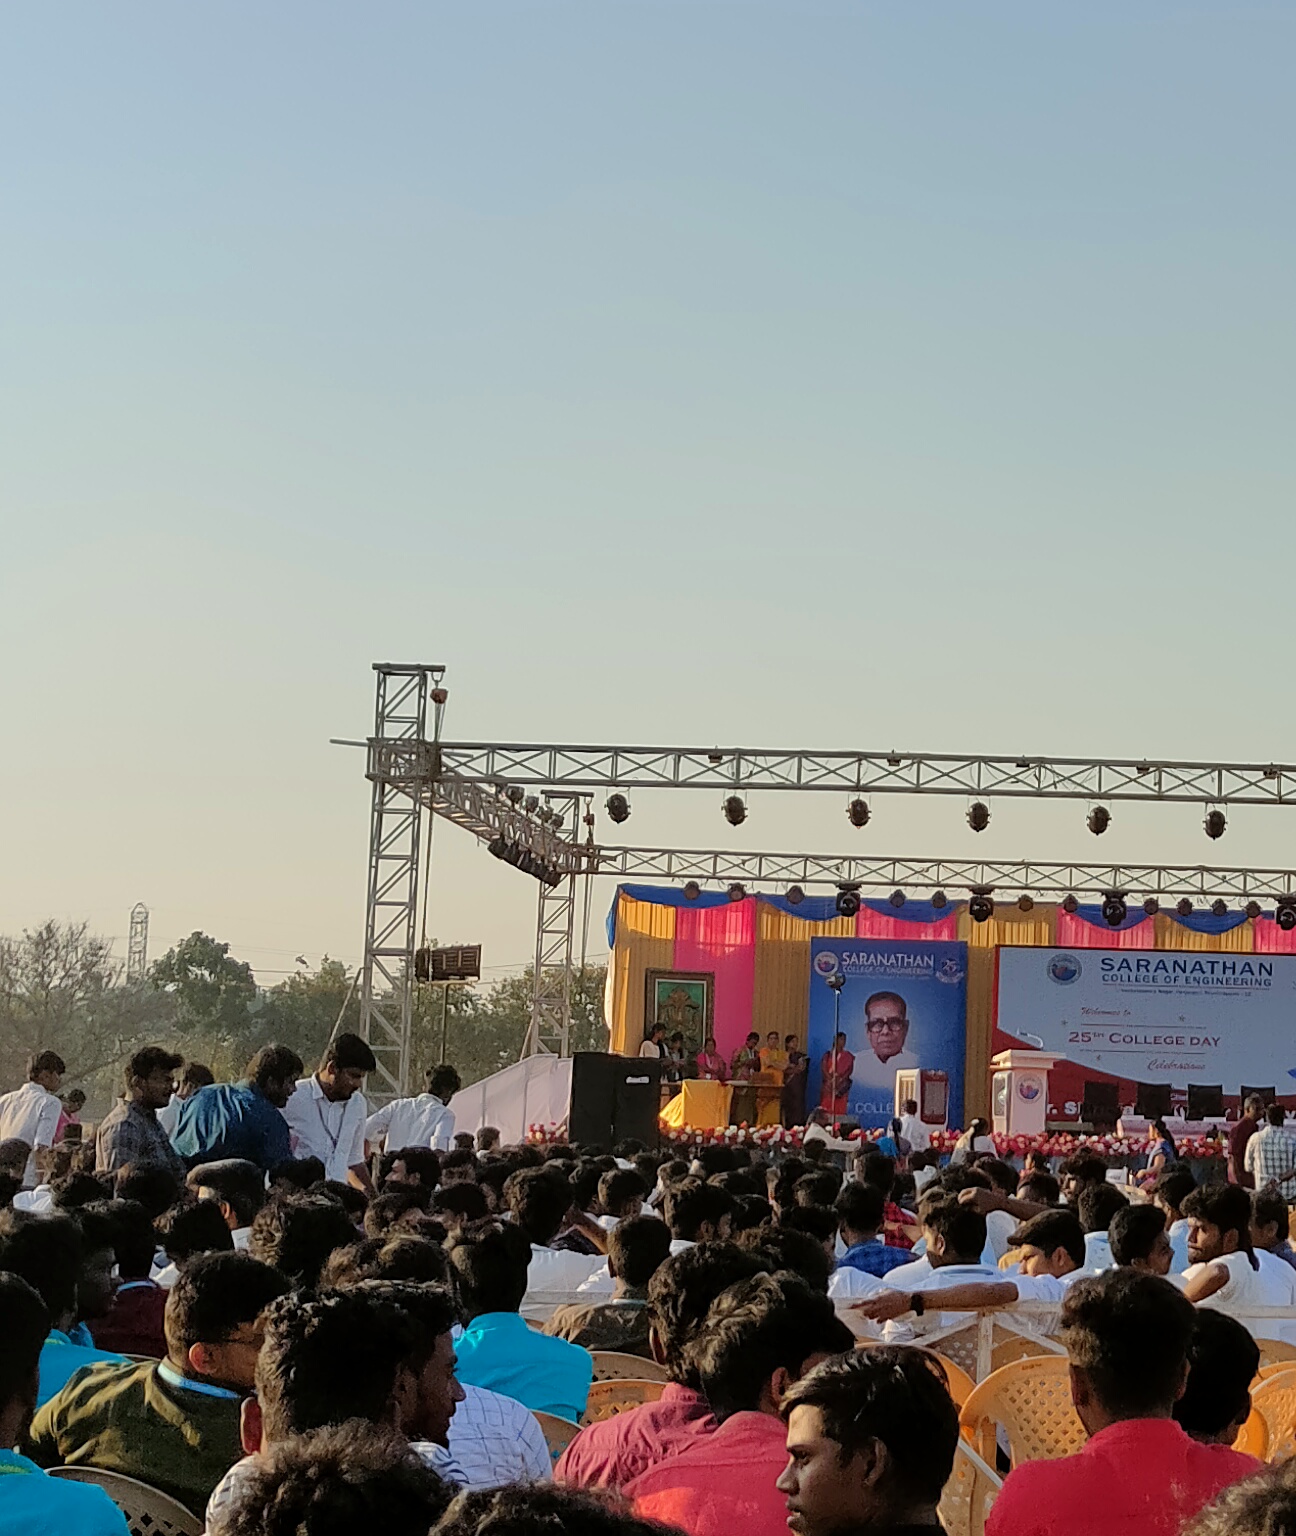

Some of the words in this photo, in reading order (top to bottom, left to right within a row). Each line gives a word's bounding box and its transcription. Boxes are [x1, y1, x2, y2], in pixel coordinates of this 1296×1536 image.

[842, 952, 934, 967] SARANATHAN
[1100, 957, 1273, 977] SARANATHAN
[1102, 974, 1159, 984] COLLEGE
[1164, 975, 1180, 984] OF
[1185, 976, 1272, 987] ENGINEERING
[1190, 1036, 1221, 1047] DAY
[855, 1102, 894, 1114] COLLE
